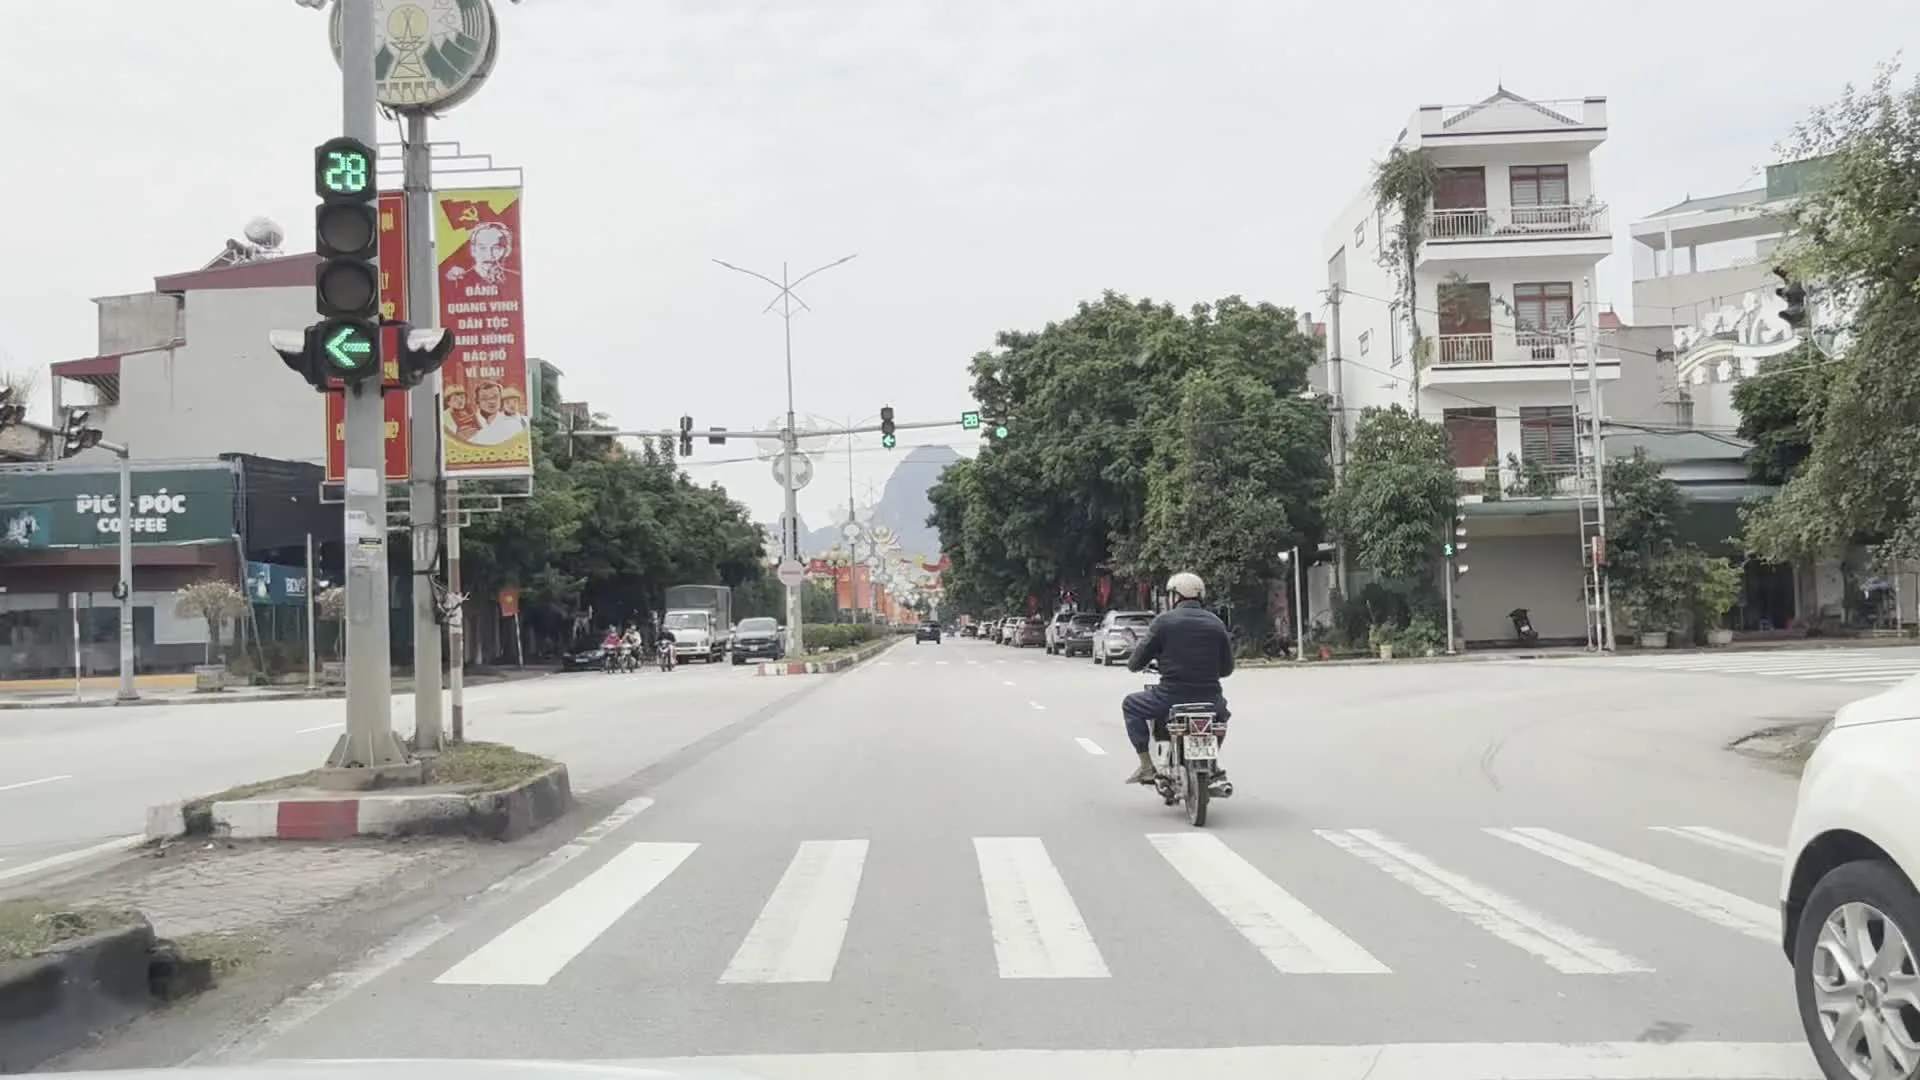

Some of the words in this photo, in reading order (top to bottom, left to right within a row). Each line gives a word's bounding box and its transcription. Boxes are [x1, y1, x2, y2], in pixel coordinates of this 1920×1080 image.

[326, 152, 366, 190] 28
[448, 302, 486, 314] QUANG
[489, 300, 518, 312] VINH
[964, 414, 978, 427] 28
[138, 487, 187, 513] PÓC
